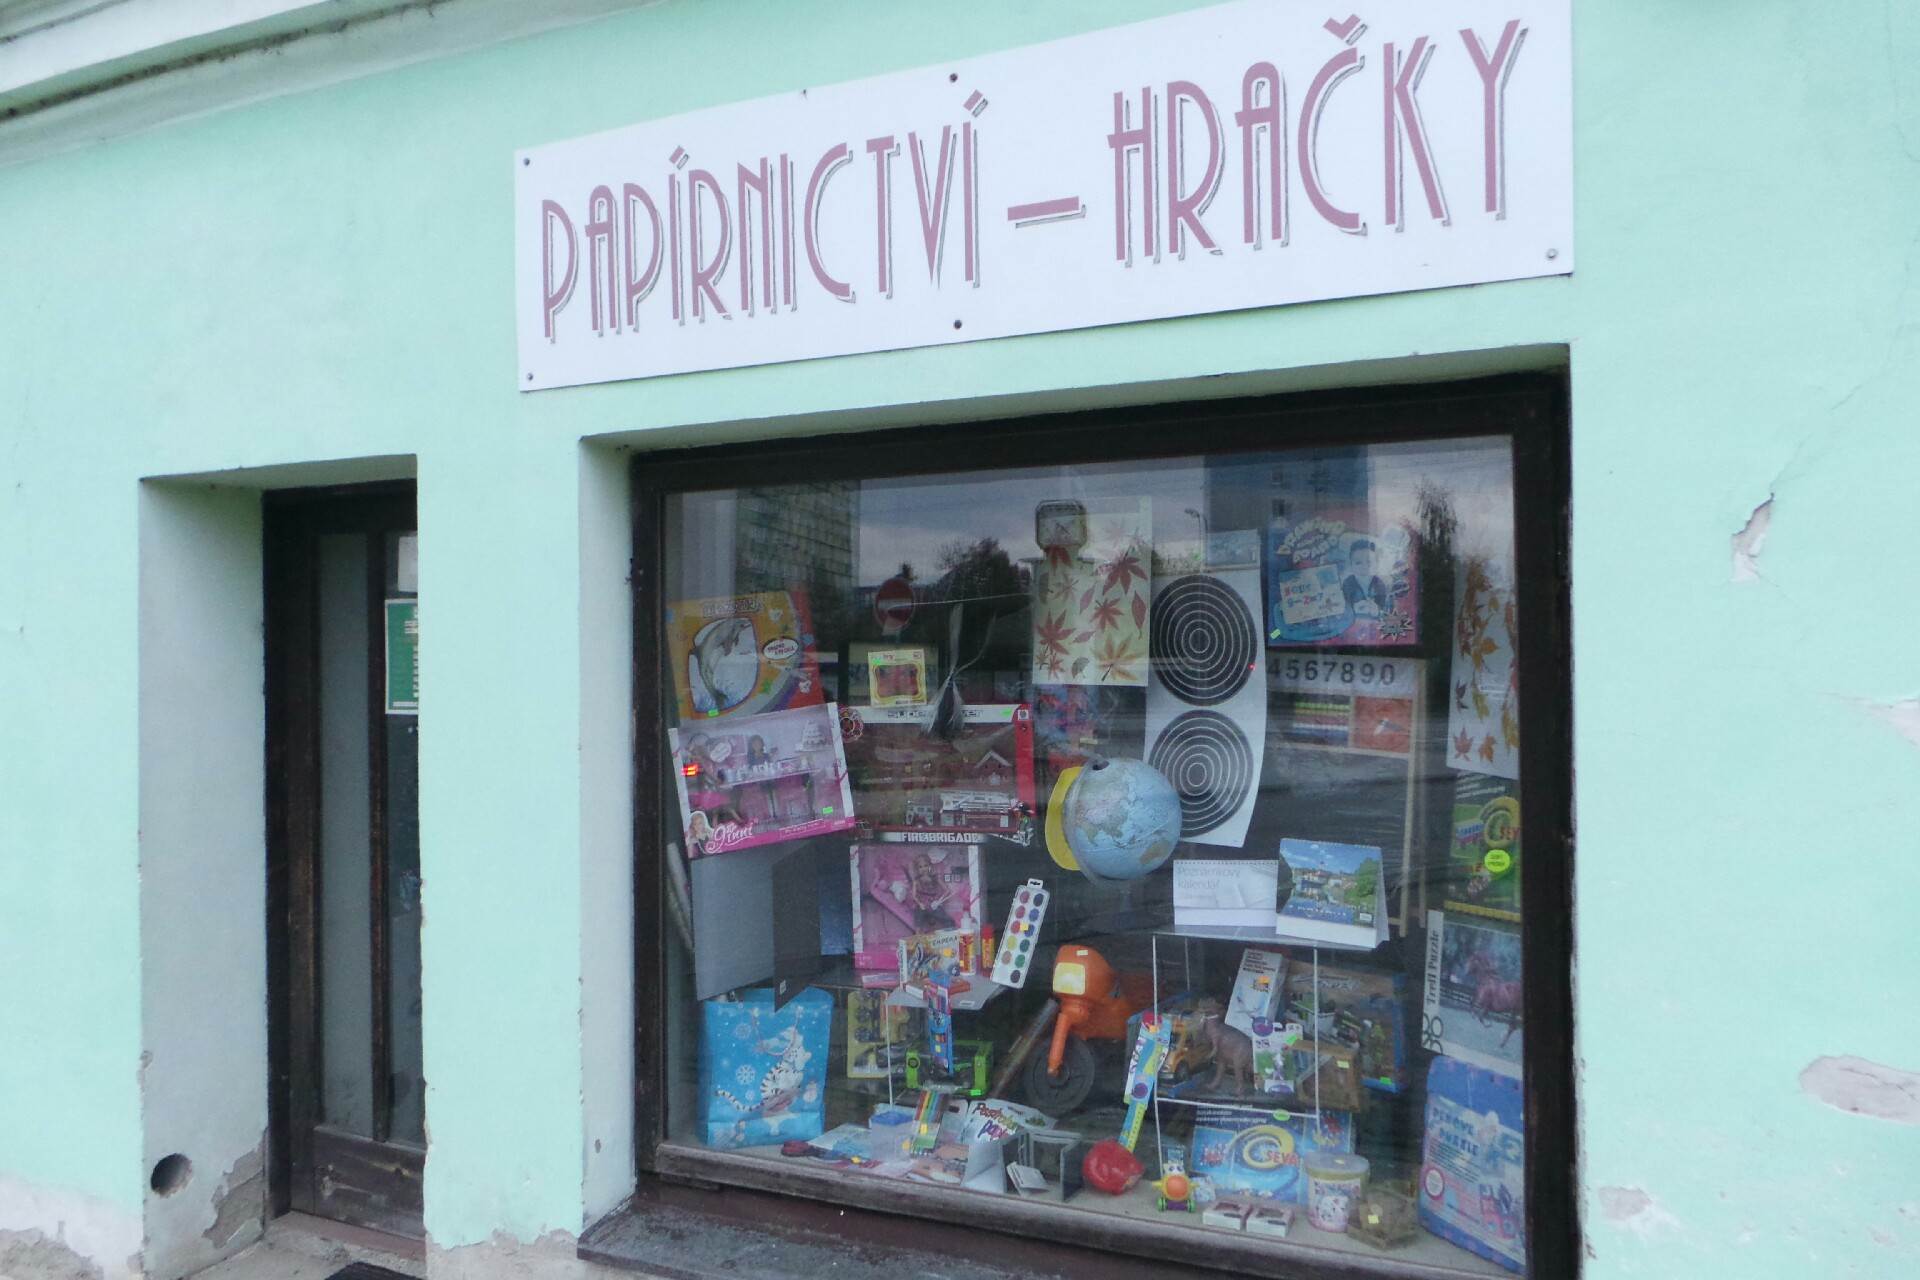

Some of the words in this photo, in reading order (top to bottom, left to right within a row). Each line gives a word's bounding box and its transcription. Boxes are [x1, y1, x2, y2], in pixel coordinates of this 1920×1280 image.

[541, 89, 988, 343] PAPÍRNICTVÍ
[1107, 14, 1528, 268] HRAČKY
[1500, 826, 1521, 841] SEV
[1428, 930, 1440, 970] Puzzle
[1265, 1149, 1299, 1166] SEVA
